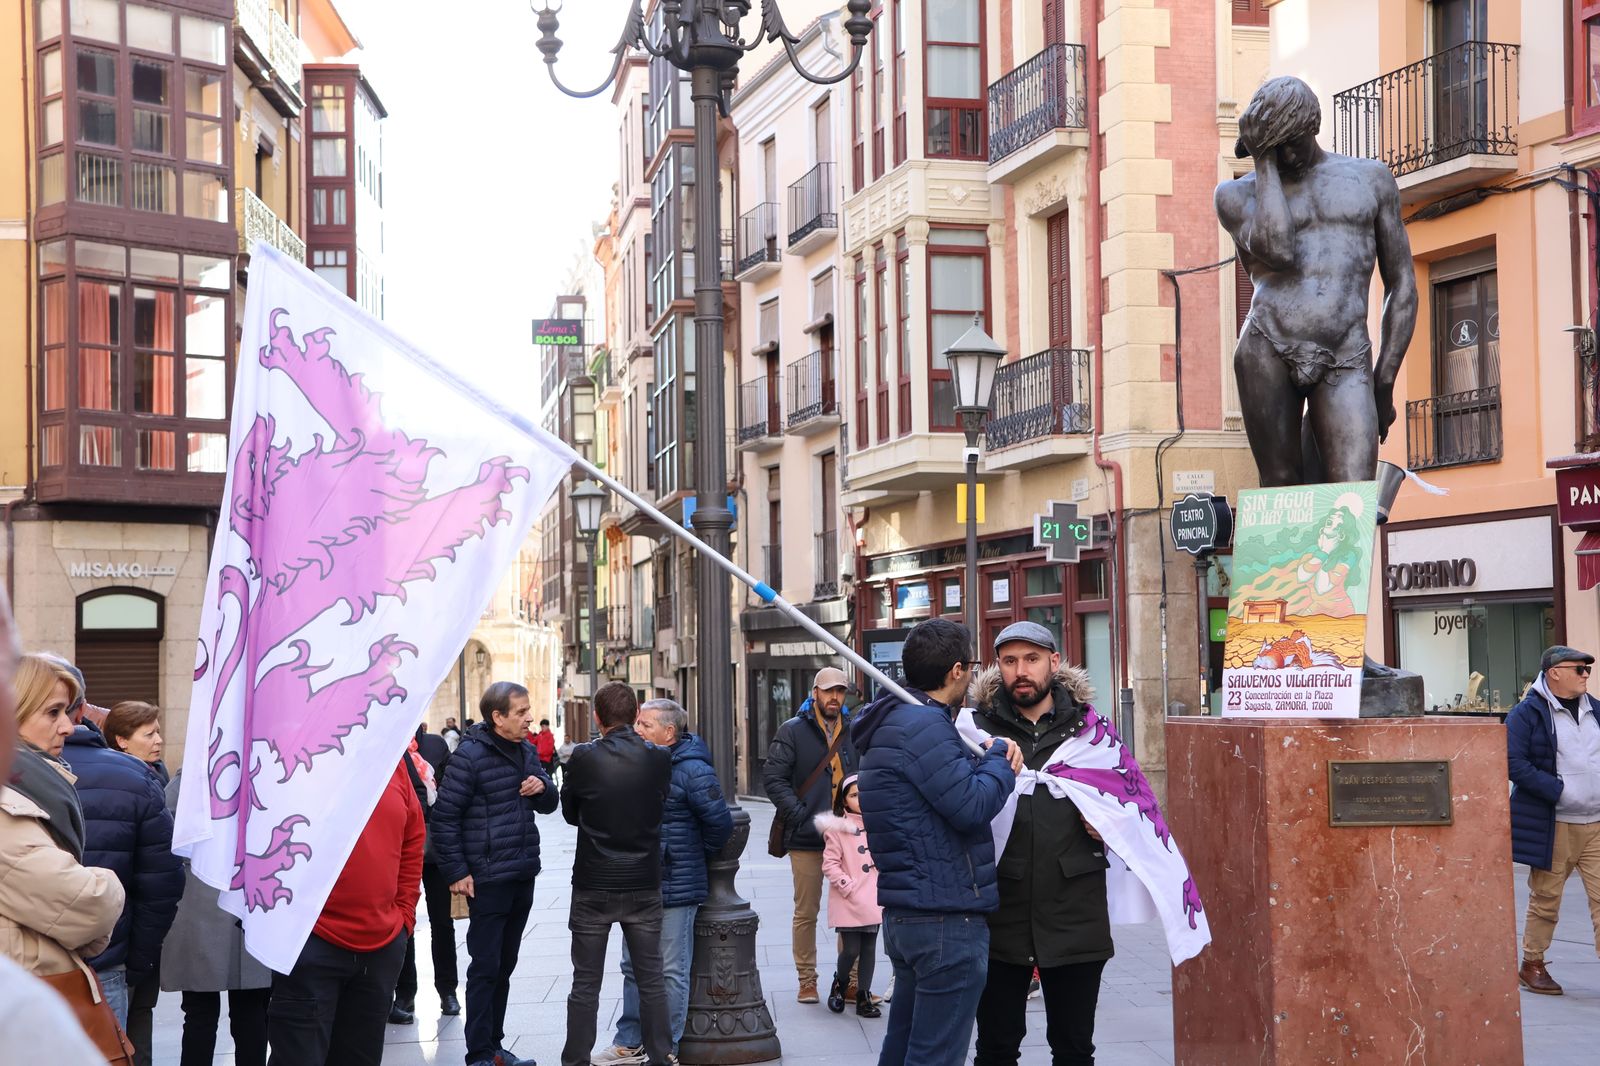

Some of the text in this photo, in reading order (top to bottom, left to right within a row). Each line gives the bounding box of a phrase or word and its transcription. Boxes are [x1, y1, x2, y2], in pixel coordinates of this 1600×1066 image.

[536, 335, 578, 345] BOLSOS
[1243, 491, 1314, 512] SIN AGUA
[1180, 508, 1204, 522] TEATRO
[1241, 508, 1313, 528] NO HAY VIDA
[1042, 522, 1088, 540] 21 °C
[1177, 526, 1210, 540] PRINCIPAL
[70, 562, 142, 578] MISAKO
[1385, 557, 1477, 592] SOBRINO
[1227, 671, 1353, 688] SALVEMOS VILLAFÁFILA
[1227, 690, 1241, 706] 23
[1244, 690, 1334, 700] Concentración en la Plaza
[1244, 701, 1273, 712] Sagasta,
[1275, 701, 1309, 711] ZAMORA,
